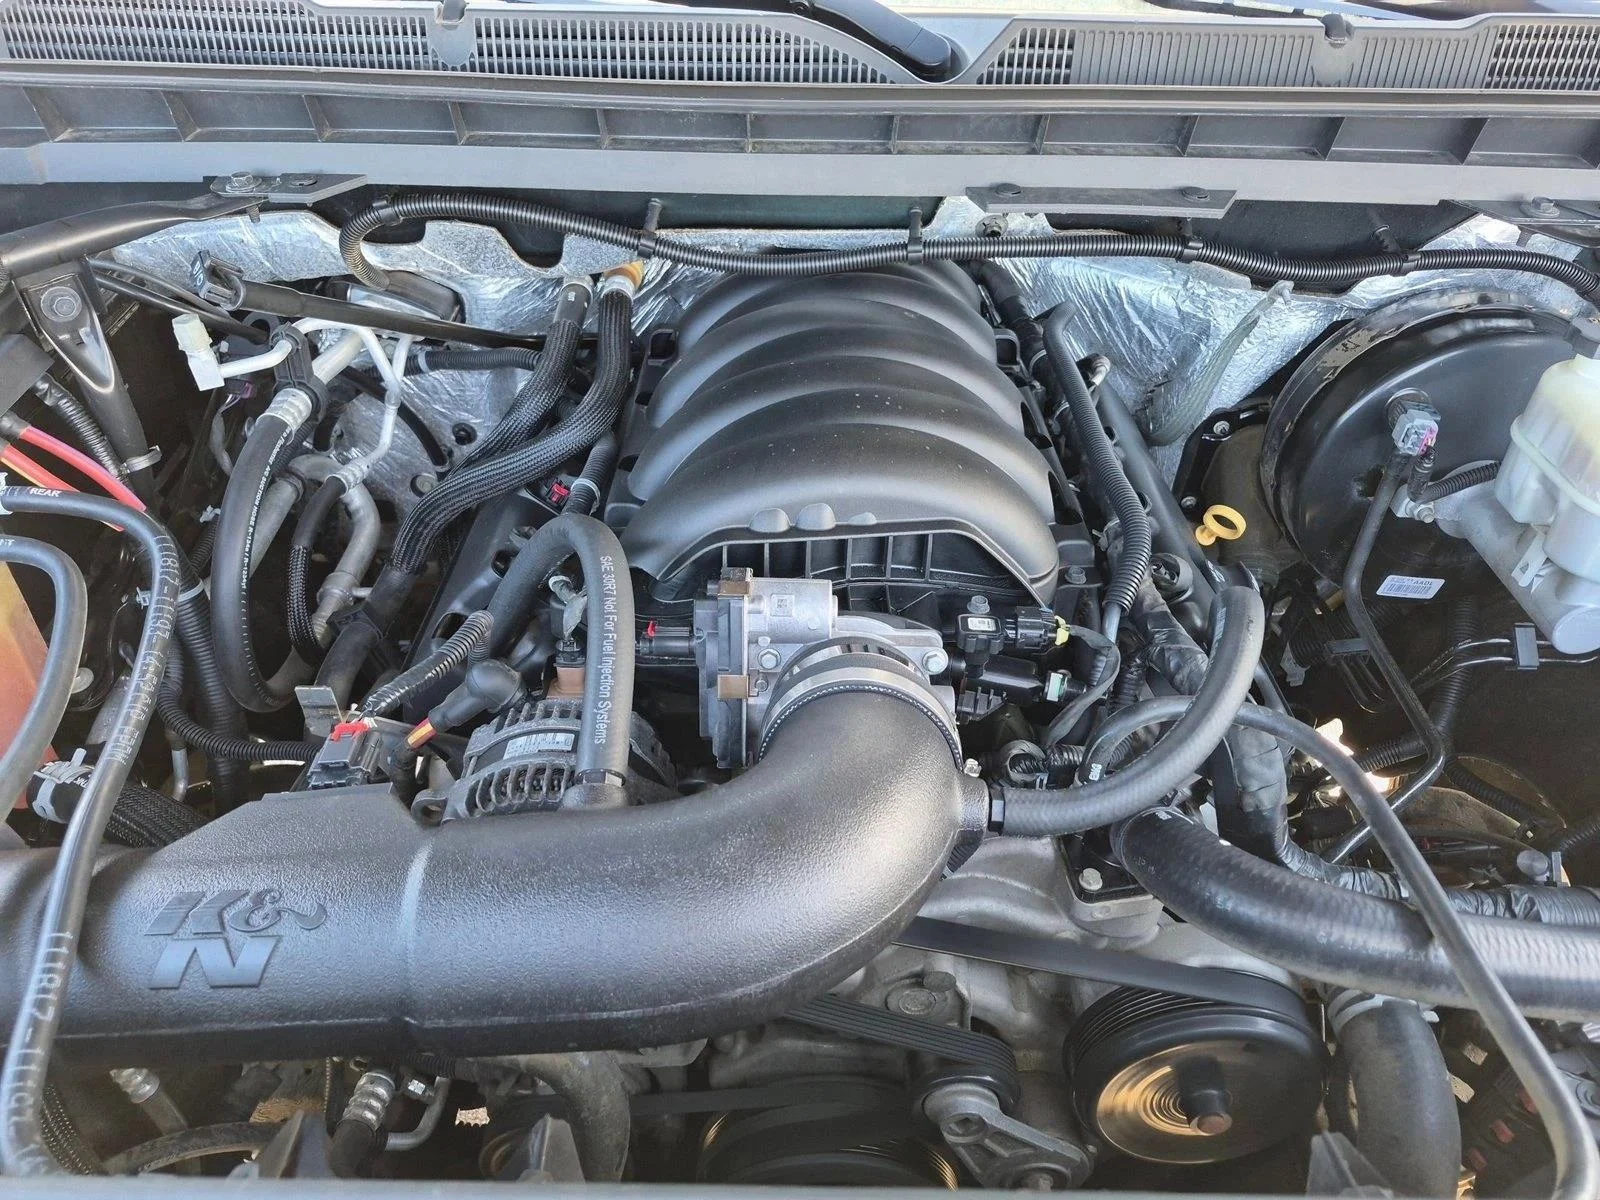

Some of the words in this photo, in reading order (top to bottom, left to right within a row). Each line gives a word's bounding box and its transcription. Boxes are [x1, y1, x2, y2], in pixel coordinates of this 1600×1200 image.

[29, 487, 62, 498] REAR
[254, 476, 268, 506] SUCTION
[249, 505, 259, 526] HOSE
[599, 555, 614, 572] SAE
[602, 573, 617, 596] 30R7
[603, 597, 617, 613] Not
[603, 614, 617, 631] For
[602, 633, 617, 655] Fuel
[597, 656, 616, 698] Injection
[593, 700, 612, 745] Systems
